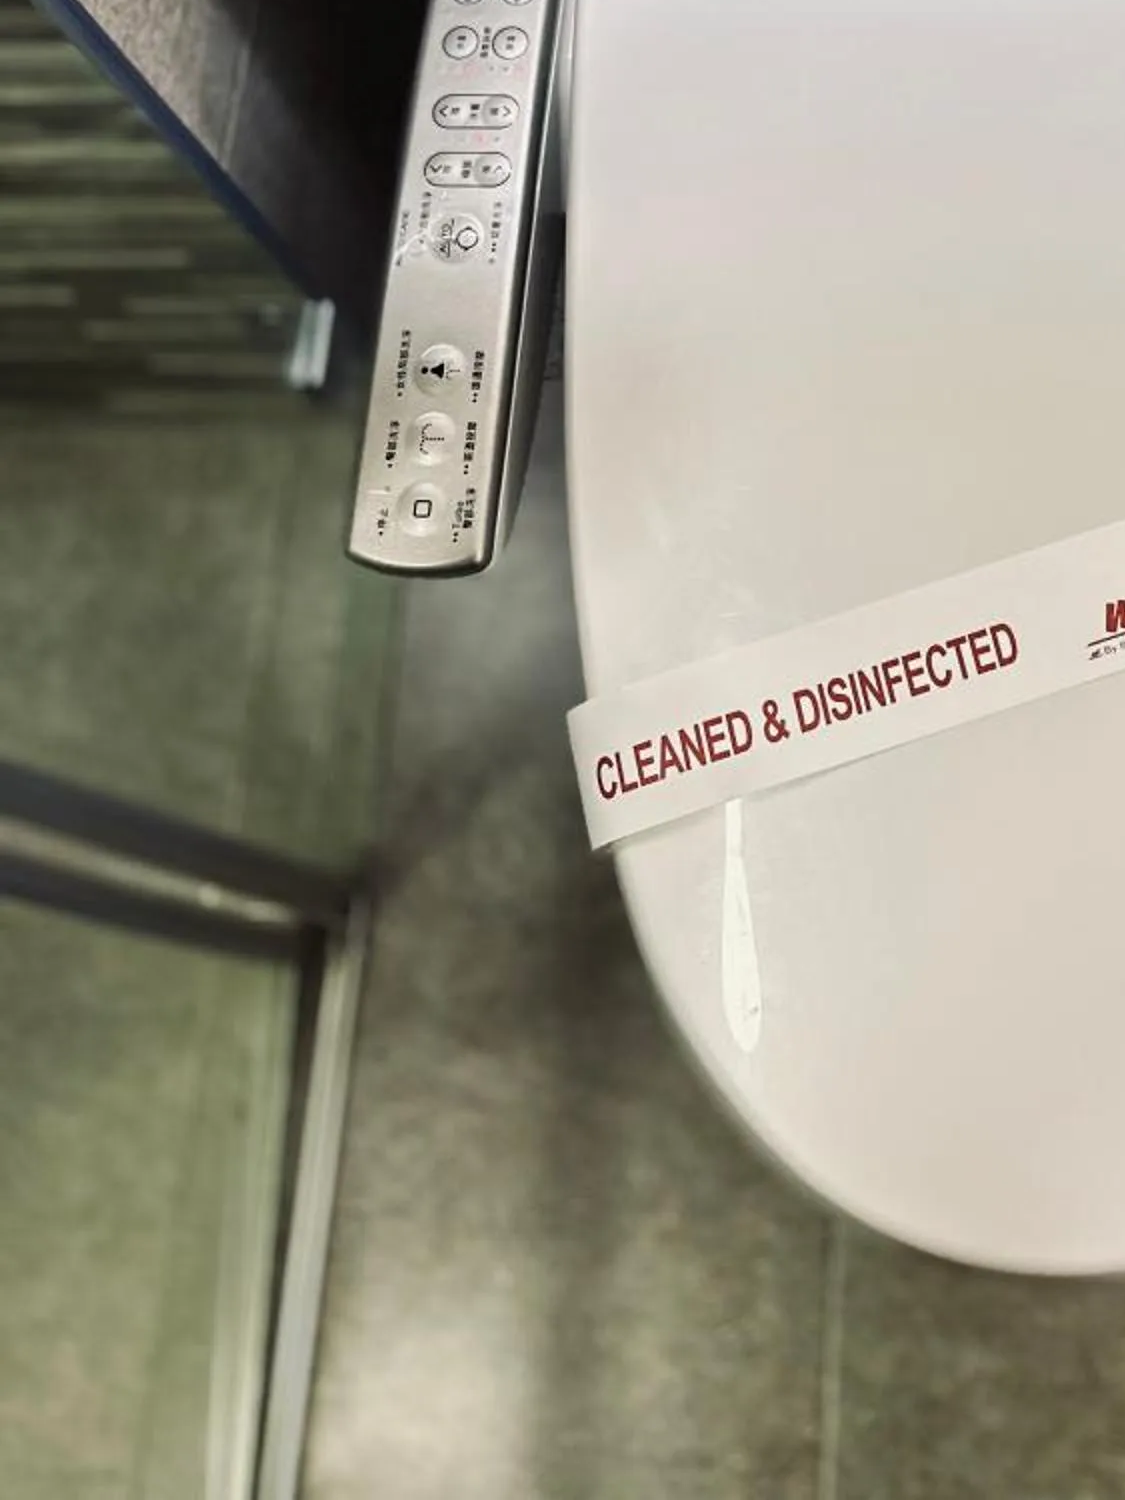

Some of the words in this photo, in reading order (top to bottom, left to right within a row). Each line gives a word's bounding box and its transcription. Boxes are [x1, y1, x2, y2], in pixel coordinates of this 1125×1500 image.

[596, 709, 754, 801] CLEANED
[763, 699, 790, 744] &
[793, 622, 1019, 734] DISINFECTED
